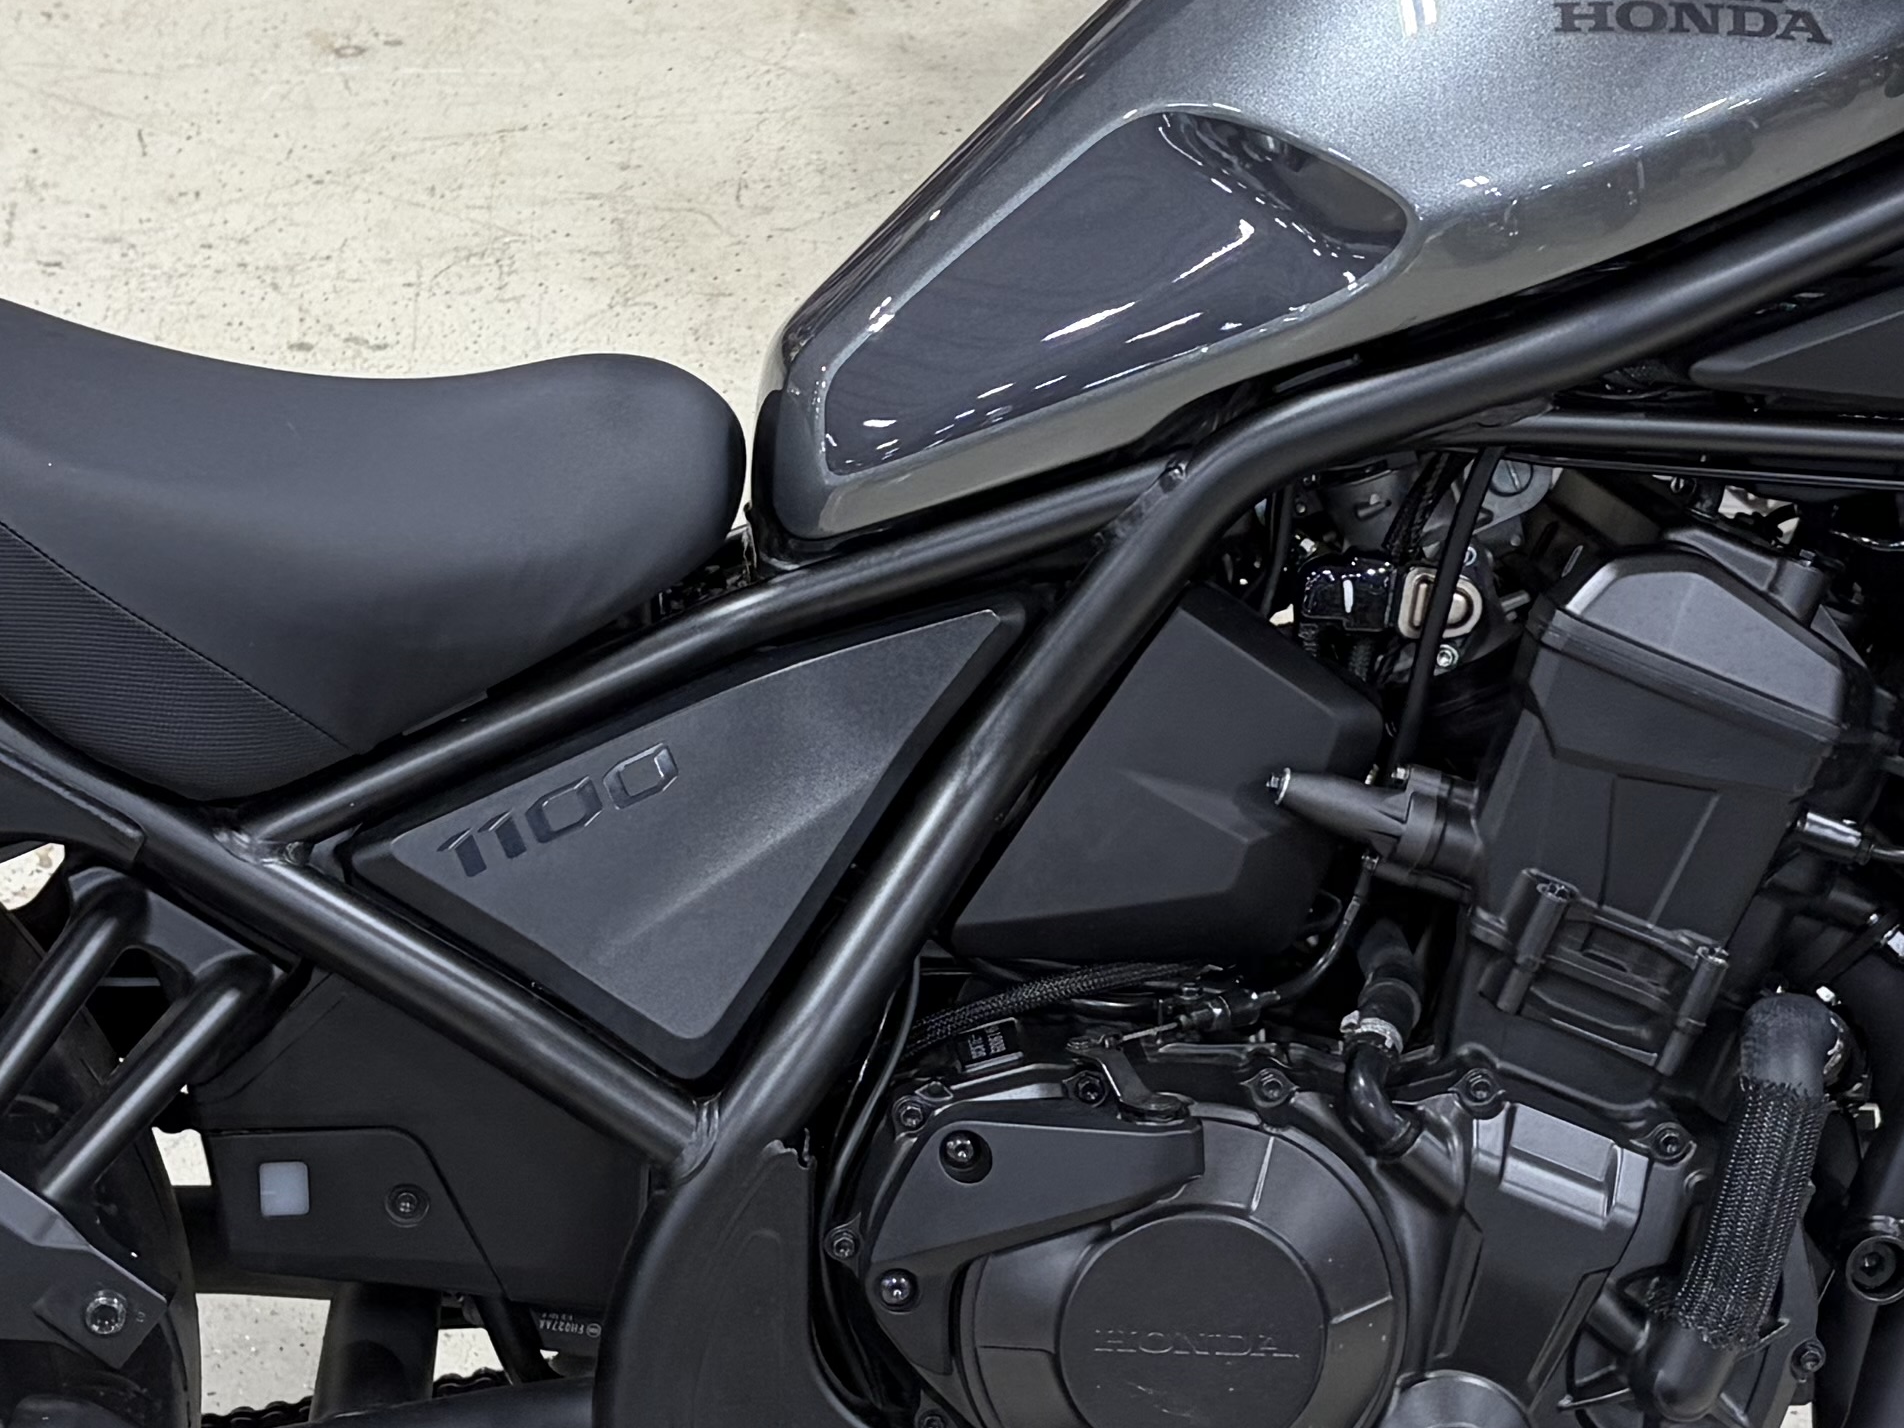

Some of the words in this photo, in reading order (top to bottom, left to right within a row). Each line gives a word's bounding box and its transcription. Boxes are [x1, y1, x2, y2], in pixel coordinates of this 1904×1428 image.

[1553, 0, 1834, 46] HONDA
[436, 741, 681, 879] 1100
[1092, 1327, 1302, 1361] HONDA
